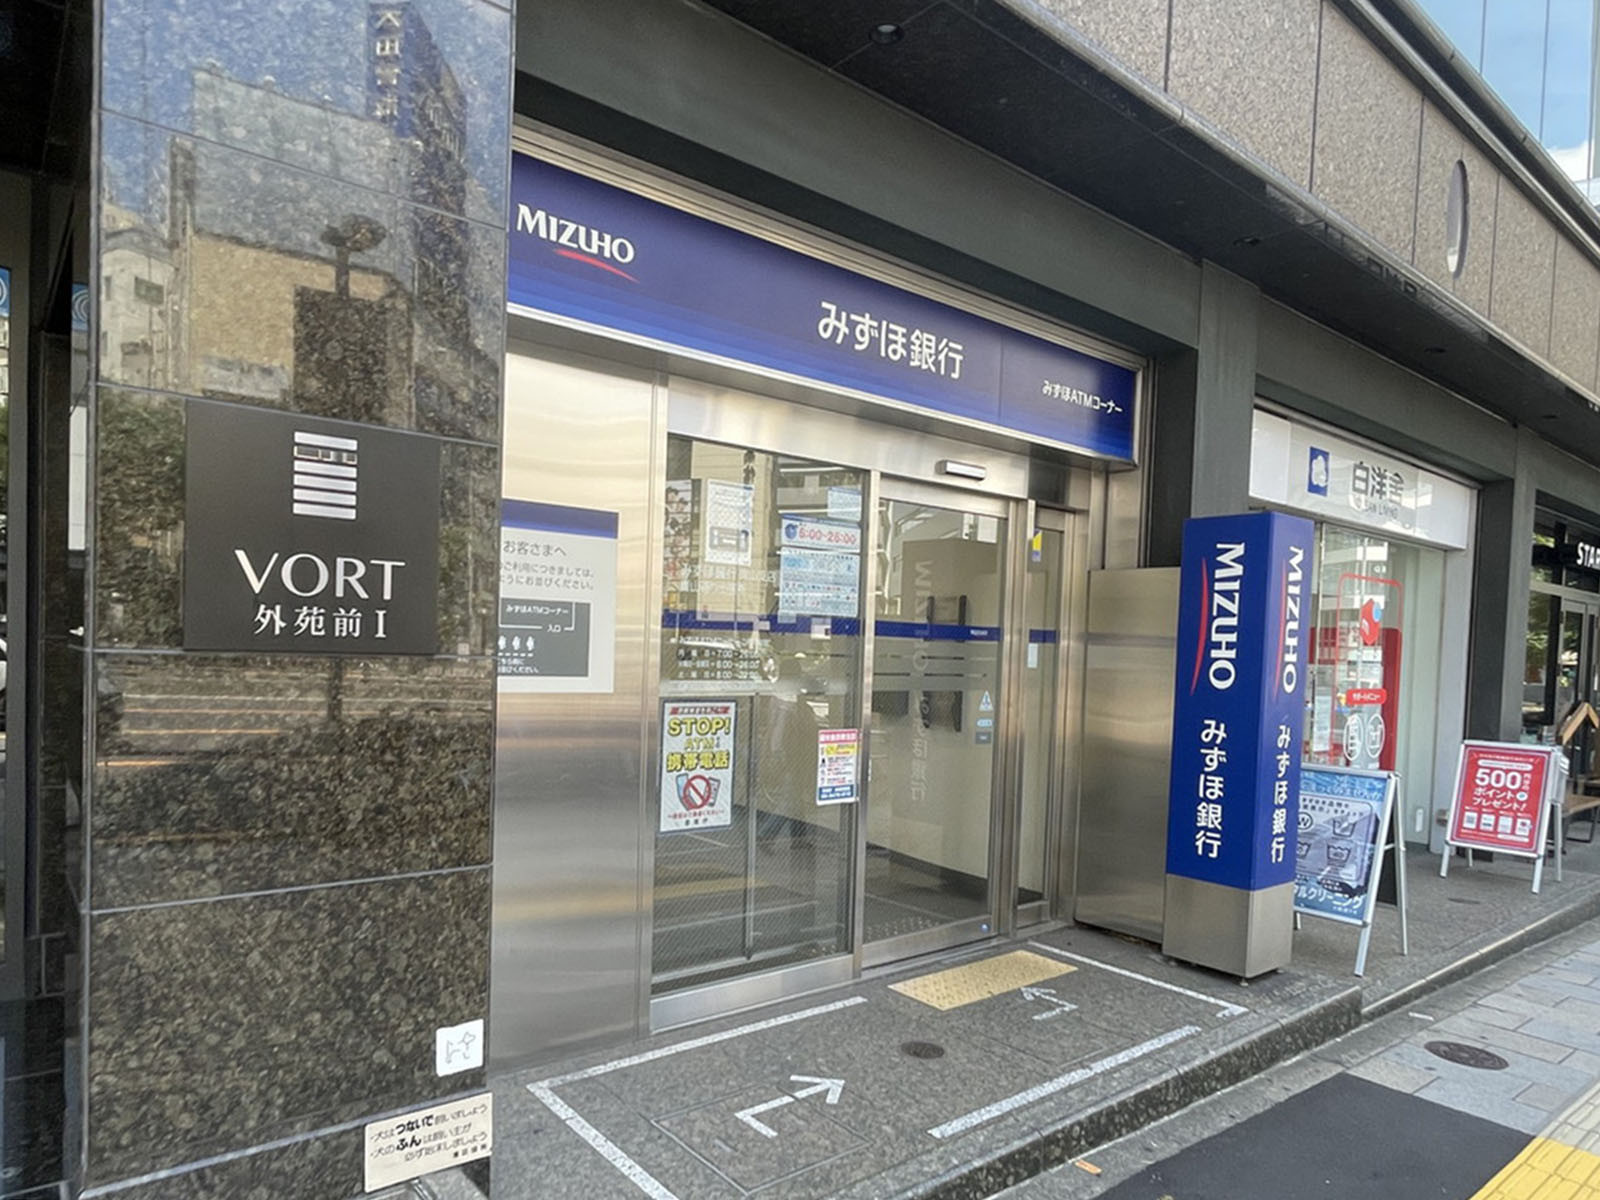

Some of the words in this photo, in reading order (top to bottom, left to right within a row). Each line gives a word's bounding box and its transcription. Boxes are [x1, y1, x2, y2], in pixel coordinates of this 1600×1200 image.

[517, 203, 635, 263] MIZUHO
[818, 301, 964, 380] みずほ銀行
[1042, 380, 1123, 414] みずほATMコーナー
[234, 549, 406, 600] VORT
[254, 604, 362, 638] 外苑前
[1208, 542, 1246, 690] MIZUHO
[1282, 545, 1304, 694] MIZUHO
[668, 716, 731, 737] STOP!
[1195, 719, 1228, 859] みずほ銀行
[1270, 724, 1292, 864] みずほ銀行
[1473, 787, 1515, 800] ポイント
[1475, 768, 1522, 790] 500
